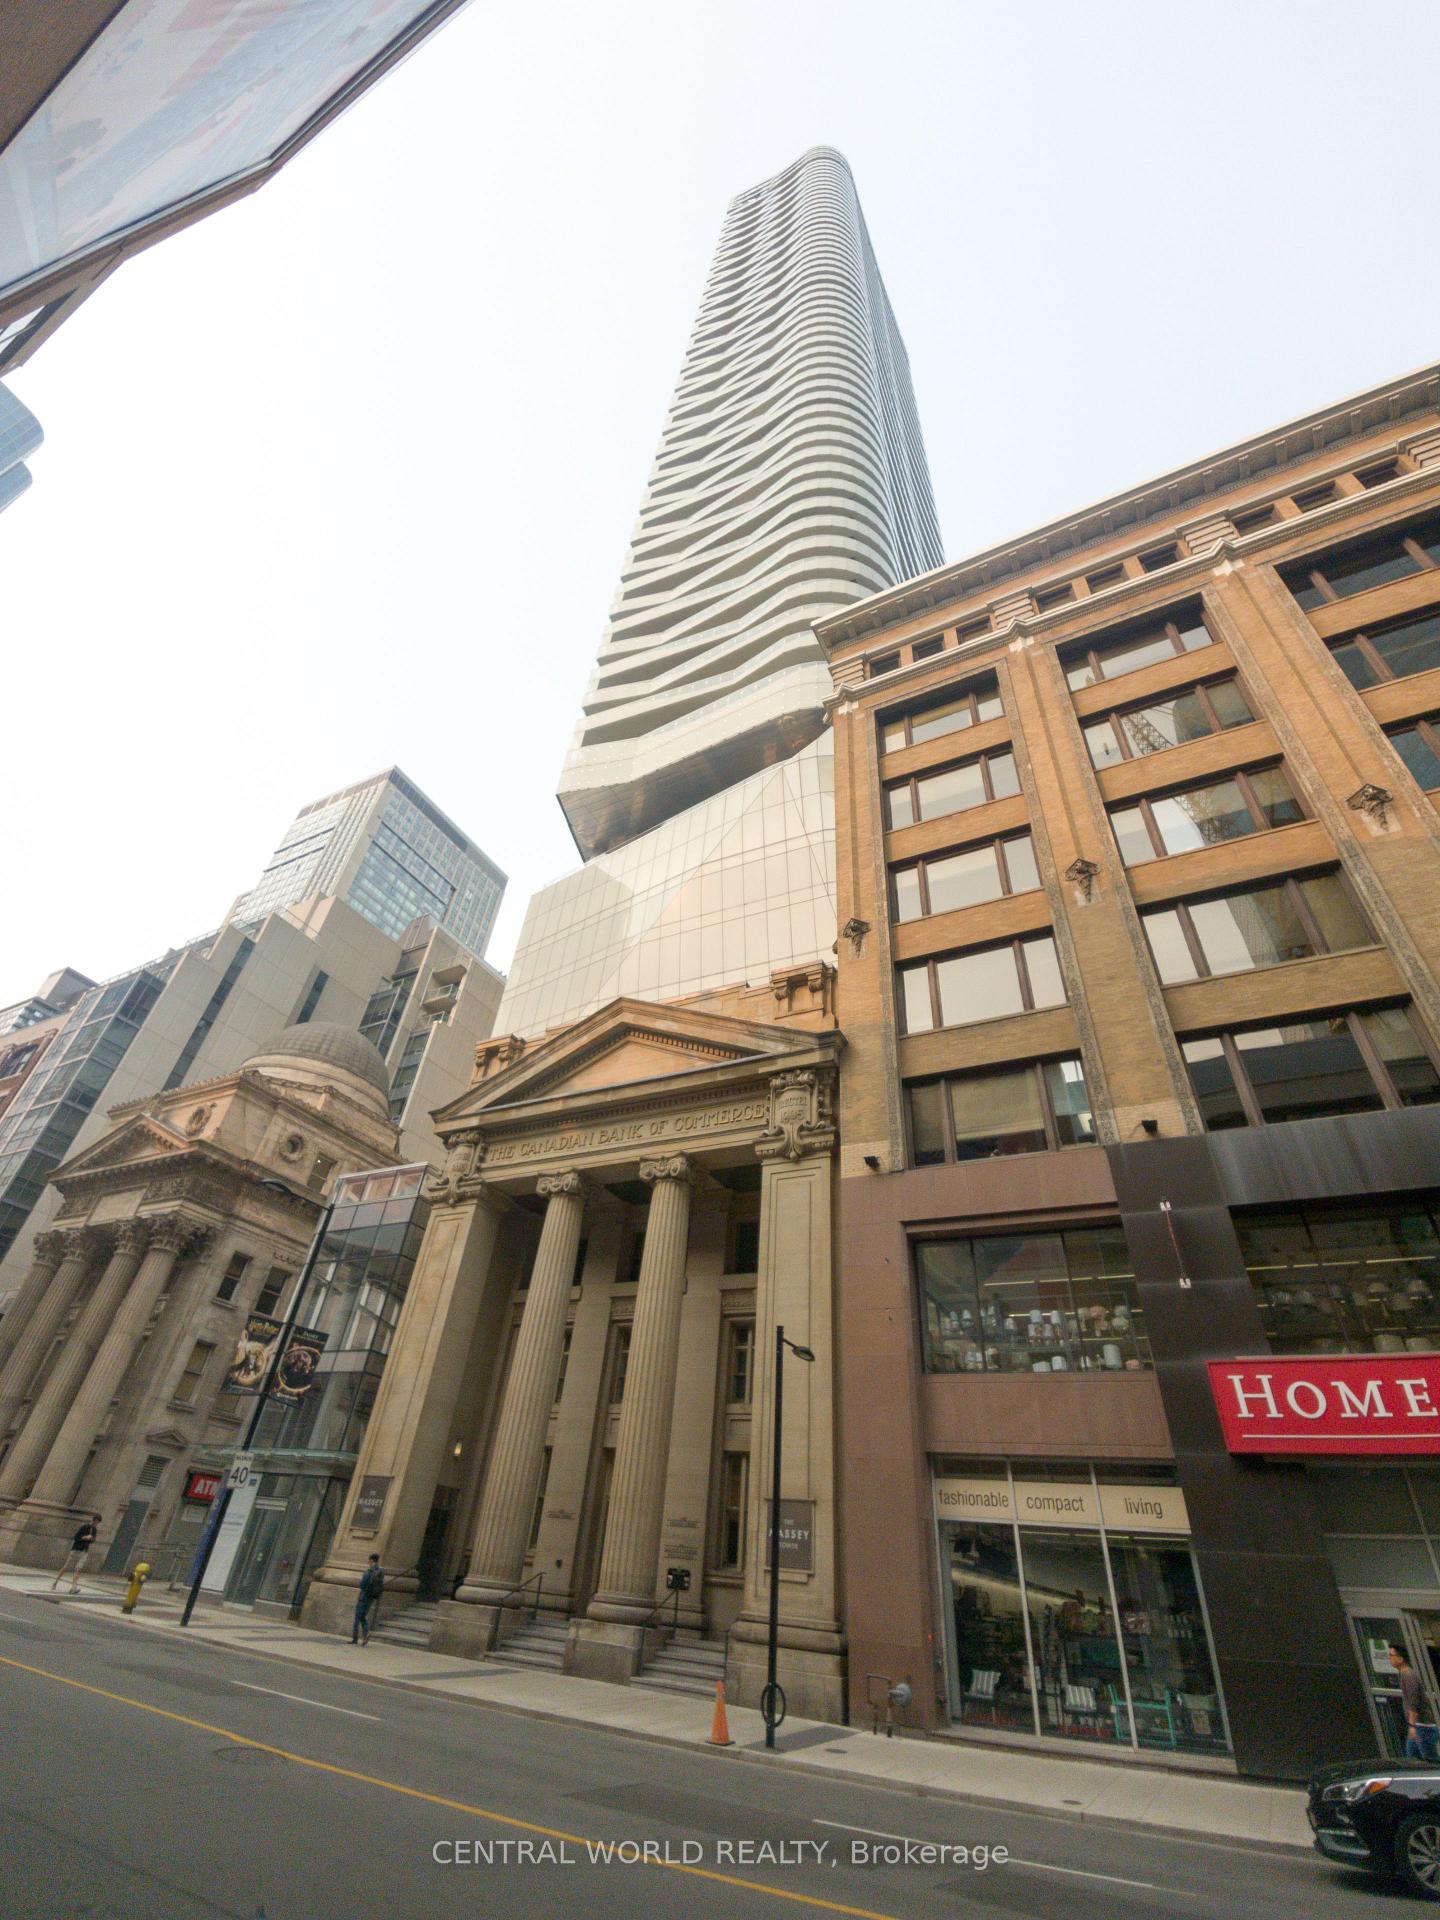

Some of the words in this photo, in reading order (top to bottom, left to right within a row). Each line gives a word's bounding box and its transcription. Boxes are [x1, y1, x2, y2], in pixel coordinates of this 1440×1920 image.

[489, 1143, 515, 1161] THE
[520, 1131, 595, 1157] CANADIAN
[598, 1122, 642, 1145] BANK
[650, 1119, 669, 1136] OF
[674, 1103, 766, 1133] COMMERCE
[1227, 1374, 1439, 1419] HOME
[230, 1467, 249, 1484] 40
[939, 1491, 1009, 1508] fashionable
[1026, 1495, 1085, 1513] compact
[1124, 1497, 1163, 1519] living
